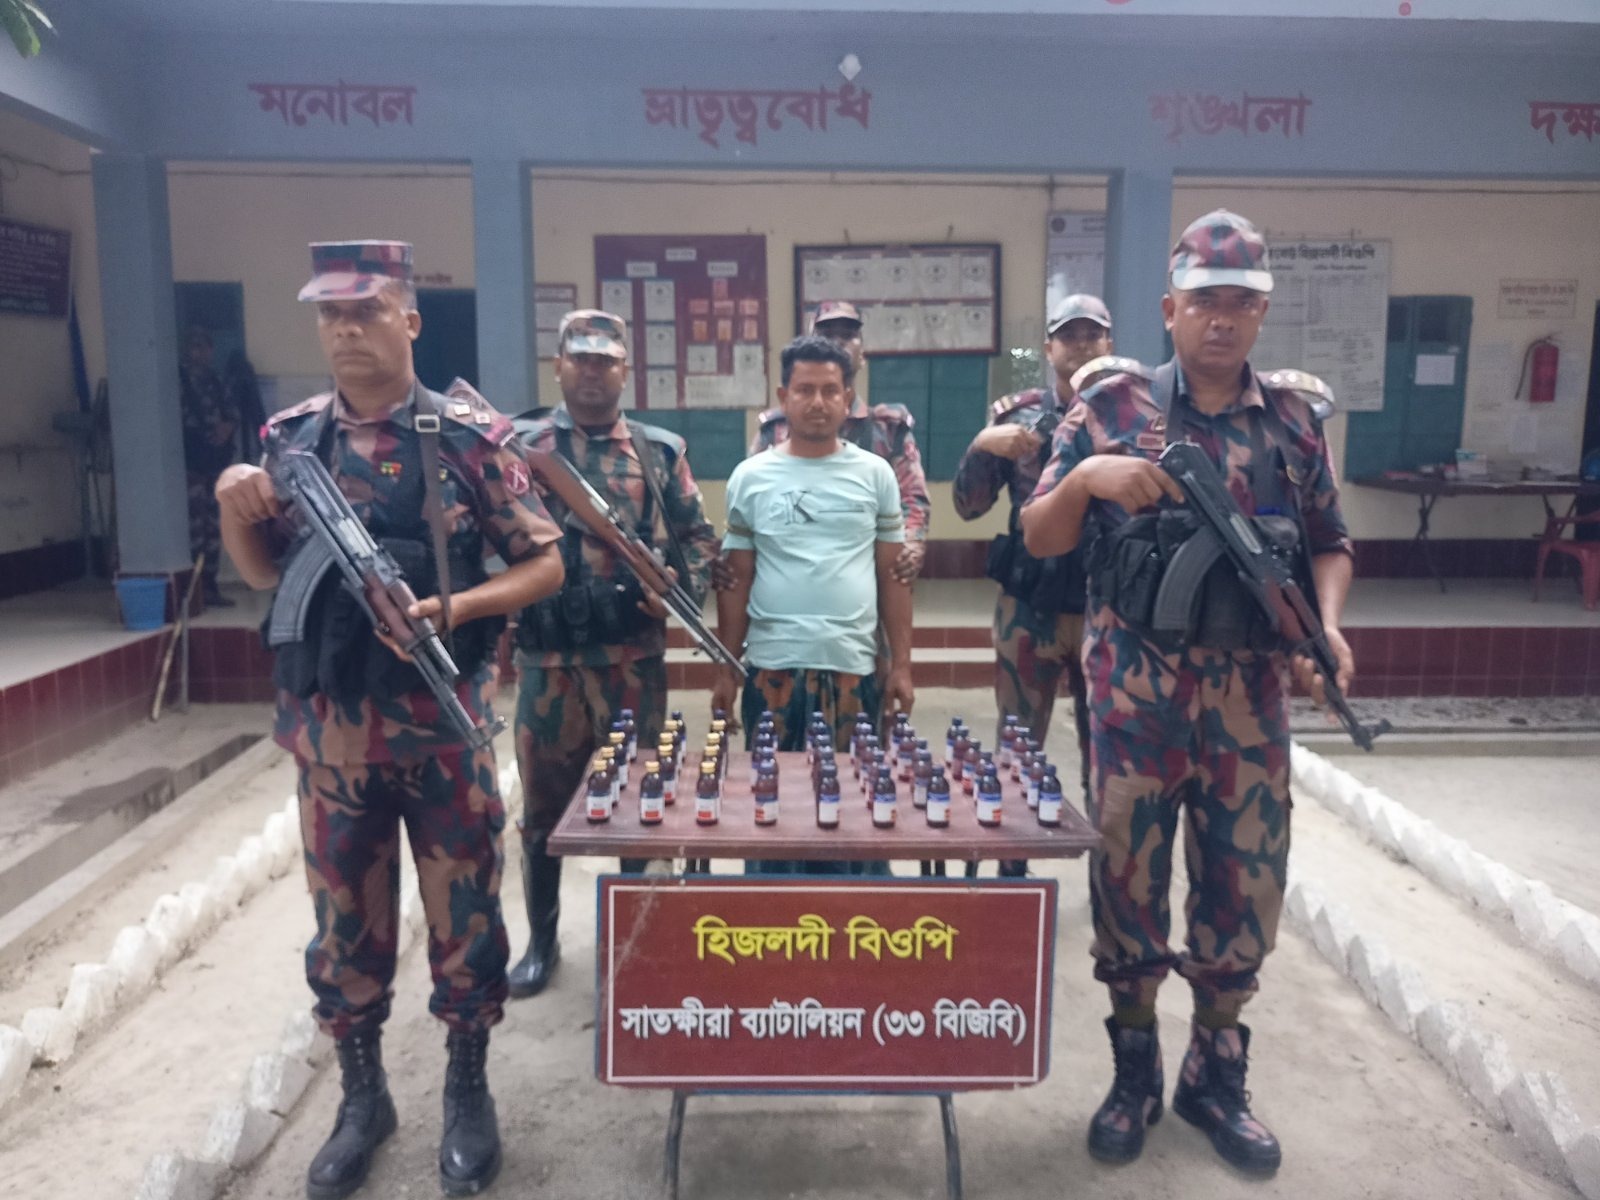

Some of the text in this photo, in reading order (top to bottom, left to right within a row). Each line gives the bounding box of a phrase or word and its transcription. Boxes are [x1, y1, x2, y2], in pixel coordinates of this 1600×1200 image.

[247, 79, 416, 127] মনোবল
[692, 914, 958, 965] হিজলদী বিওপি
[619, 996, 1027, 1047] সাতক্ষীরা ব্যাটালিয়ন (৩৩ বিজিবি)
